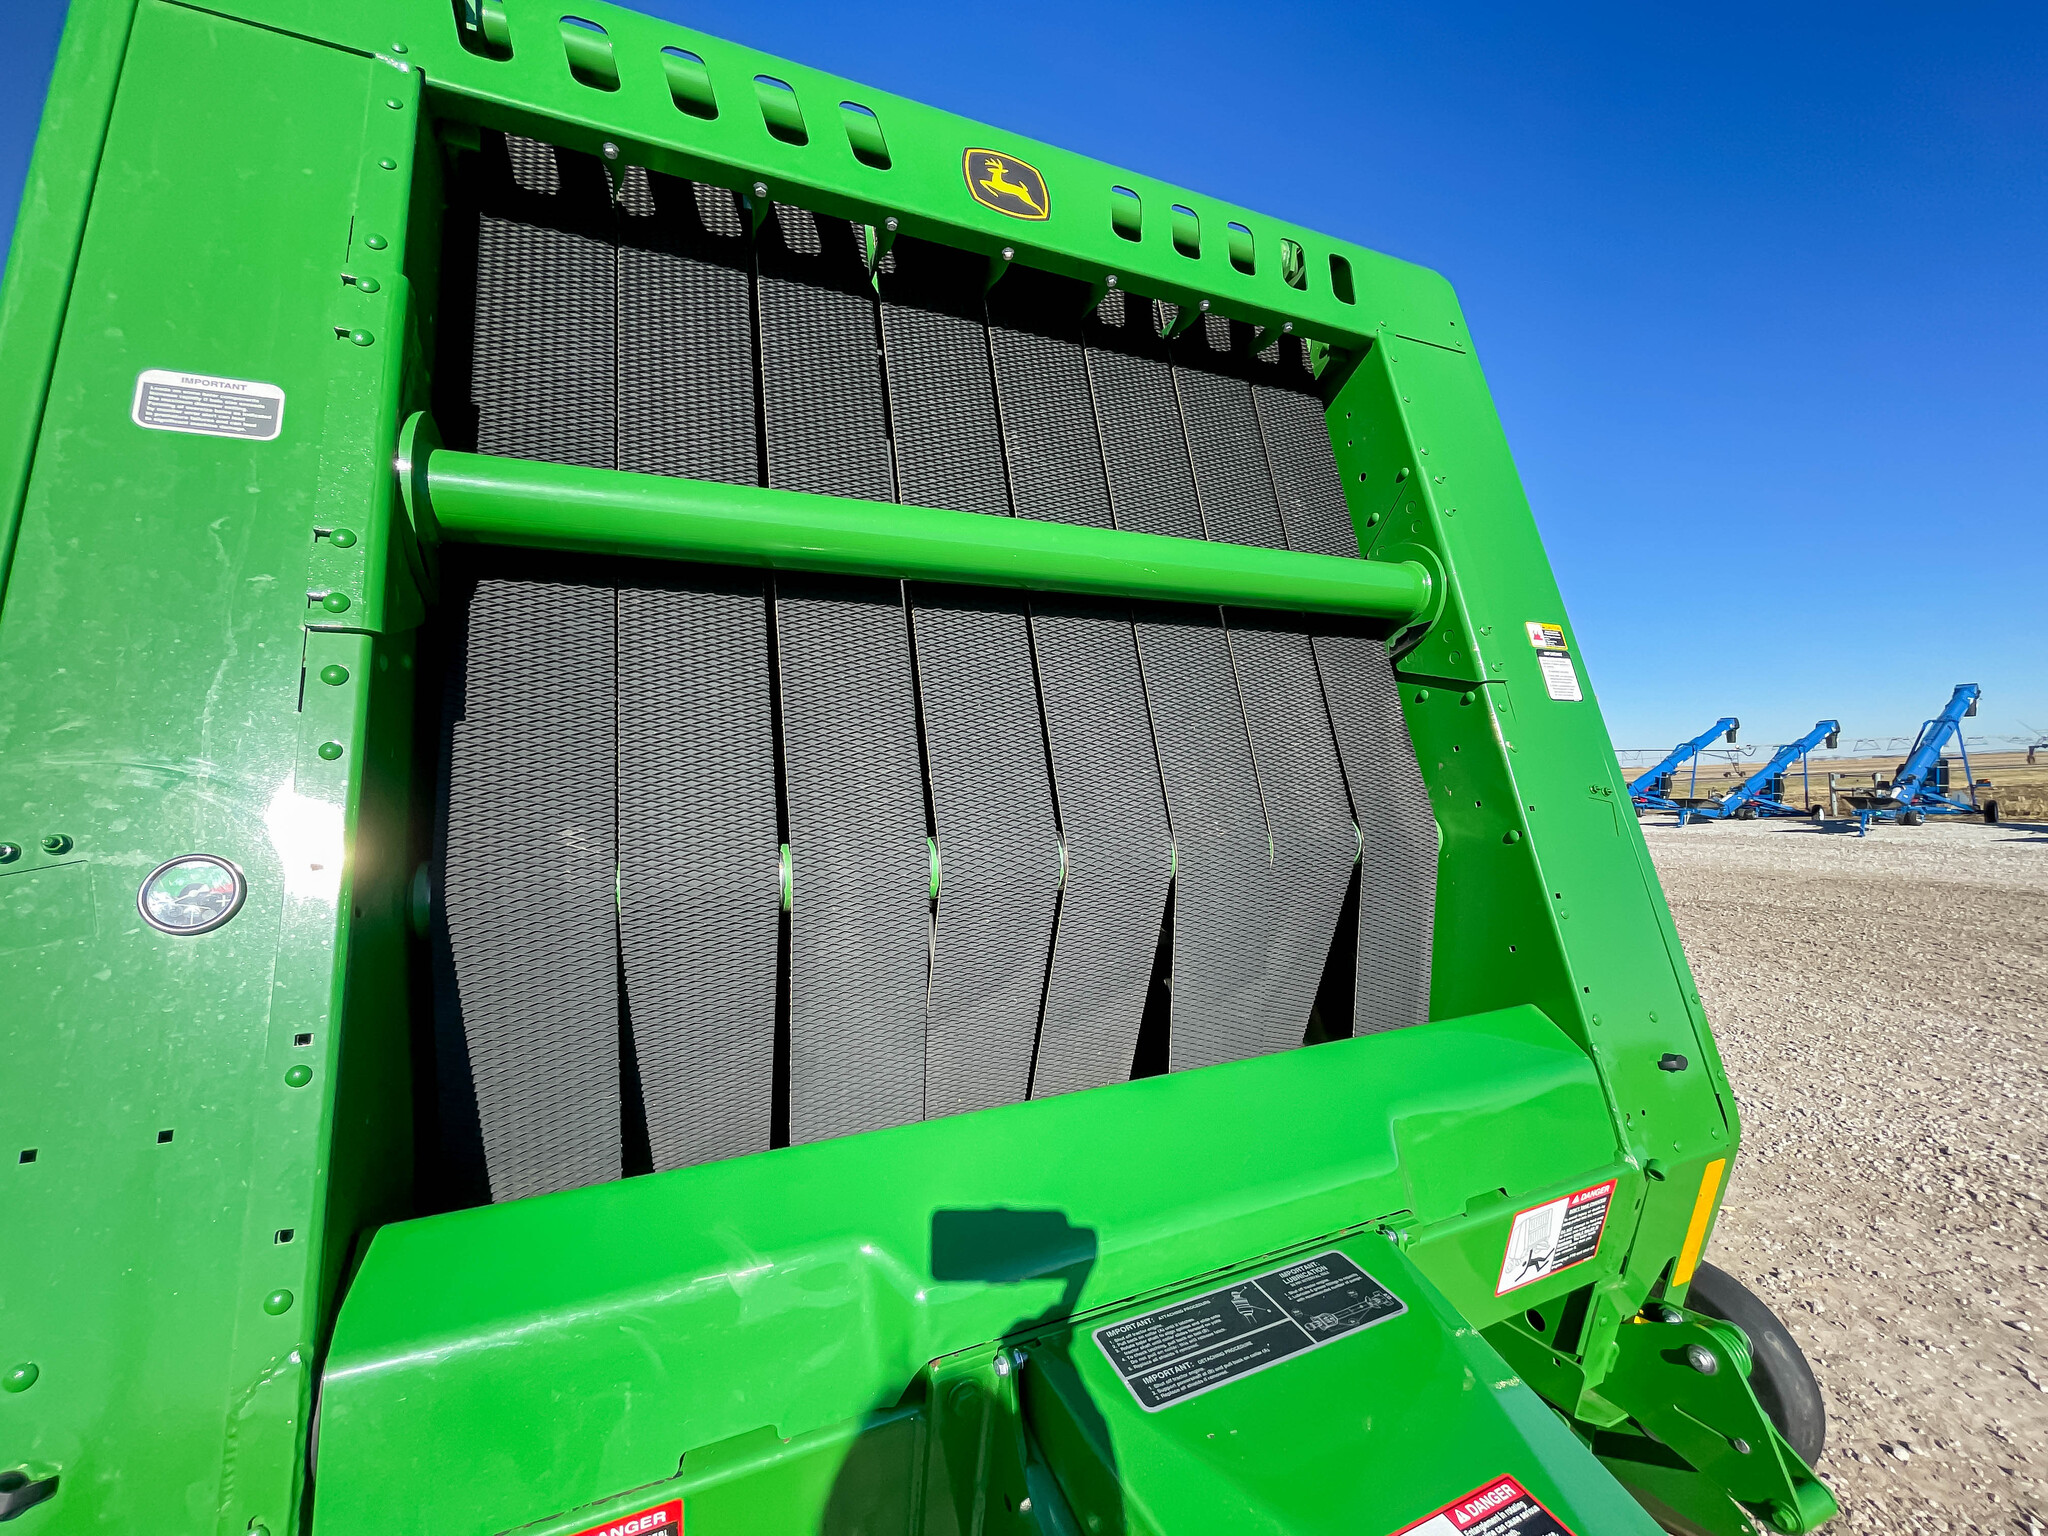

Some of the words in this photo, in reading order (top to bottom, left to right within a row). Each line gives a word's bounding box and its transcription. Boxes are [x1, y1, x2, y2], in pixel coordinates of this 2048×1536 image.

[181, 377, 247, 391] IMPORTANT
[1580, 1184, 1610, 1201] DANGER
[1278, 1261, 1320, 1279] IMPORTANT:
[1282, 1265, 1328, 1285] LUBRICATION
[1105, 1317, 1155, 1338] IMPORTANT:
[1142, 1361, 1195, 1385] IMPORTANT:
[1465, 1484, 1516, 1517] DANGER
[1497, 1512, 1507, 1520] in
[1504, 1501, 1528, 1516] rotating
[1494, 1523, 1507, 1534] can
[1504, 1515, 1522, 1529] cause
